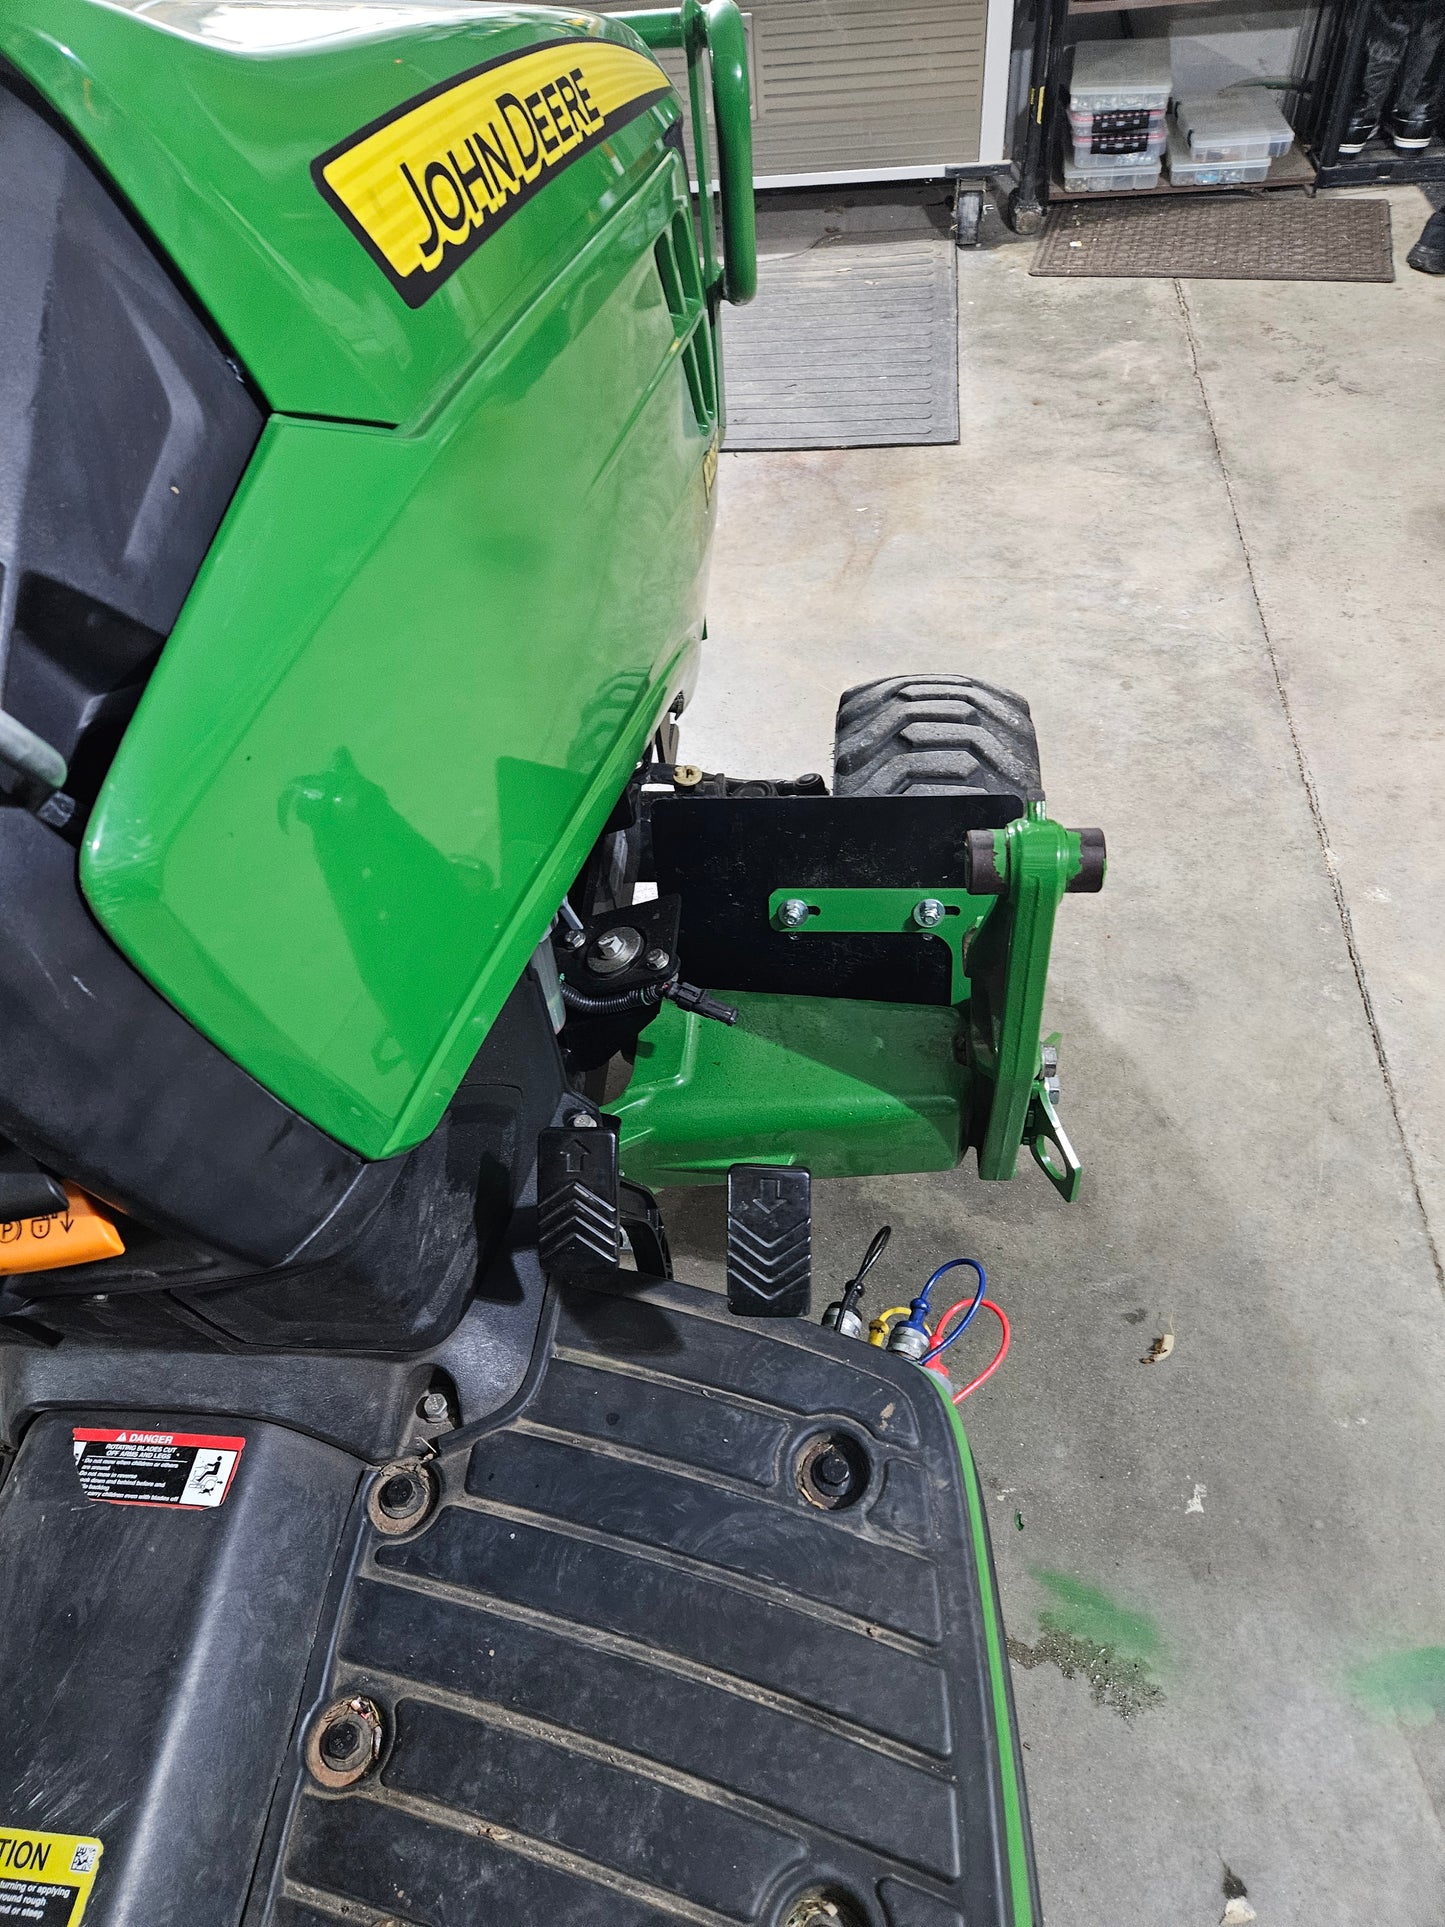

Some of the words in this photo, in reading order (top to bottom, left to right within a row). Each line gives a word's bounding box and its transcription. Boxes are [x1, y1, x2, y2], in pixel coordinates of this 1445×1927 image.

[400, 122, 516, 258] JOHN
[495, 68, 601, 171] DEERE
[129, 1433, 173, 1444] DANGER
[105, 1443, 136, 1451] ROTATING
[137, 1445, 162, 1453] BLADES
[88, 1483, 110, 1491] backing
[0, 1880, 27, 1893] turning
[27, 1884, 37, 1892] or
[36, 1885, 71, 1898] applying
[23, 1895, 47, 1907] rough
